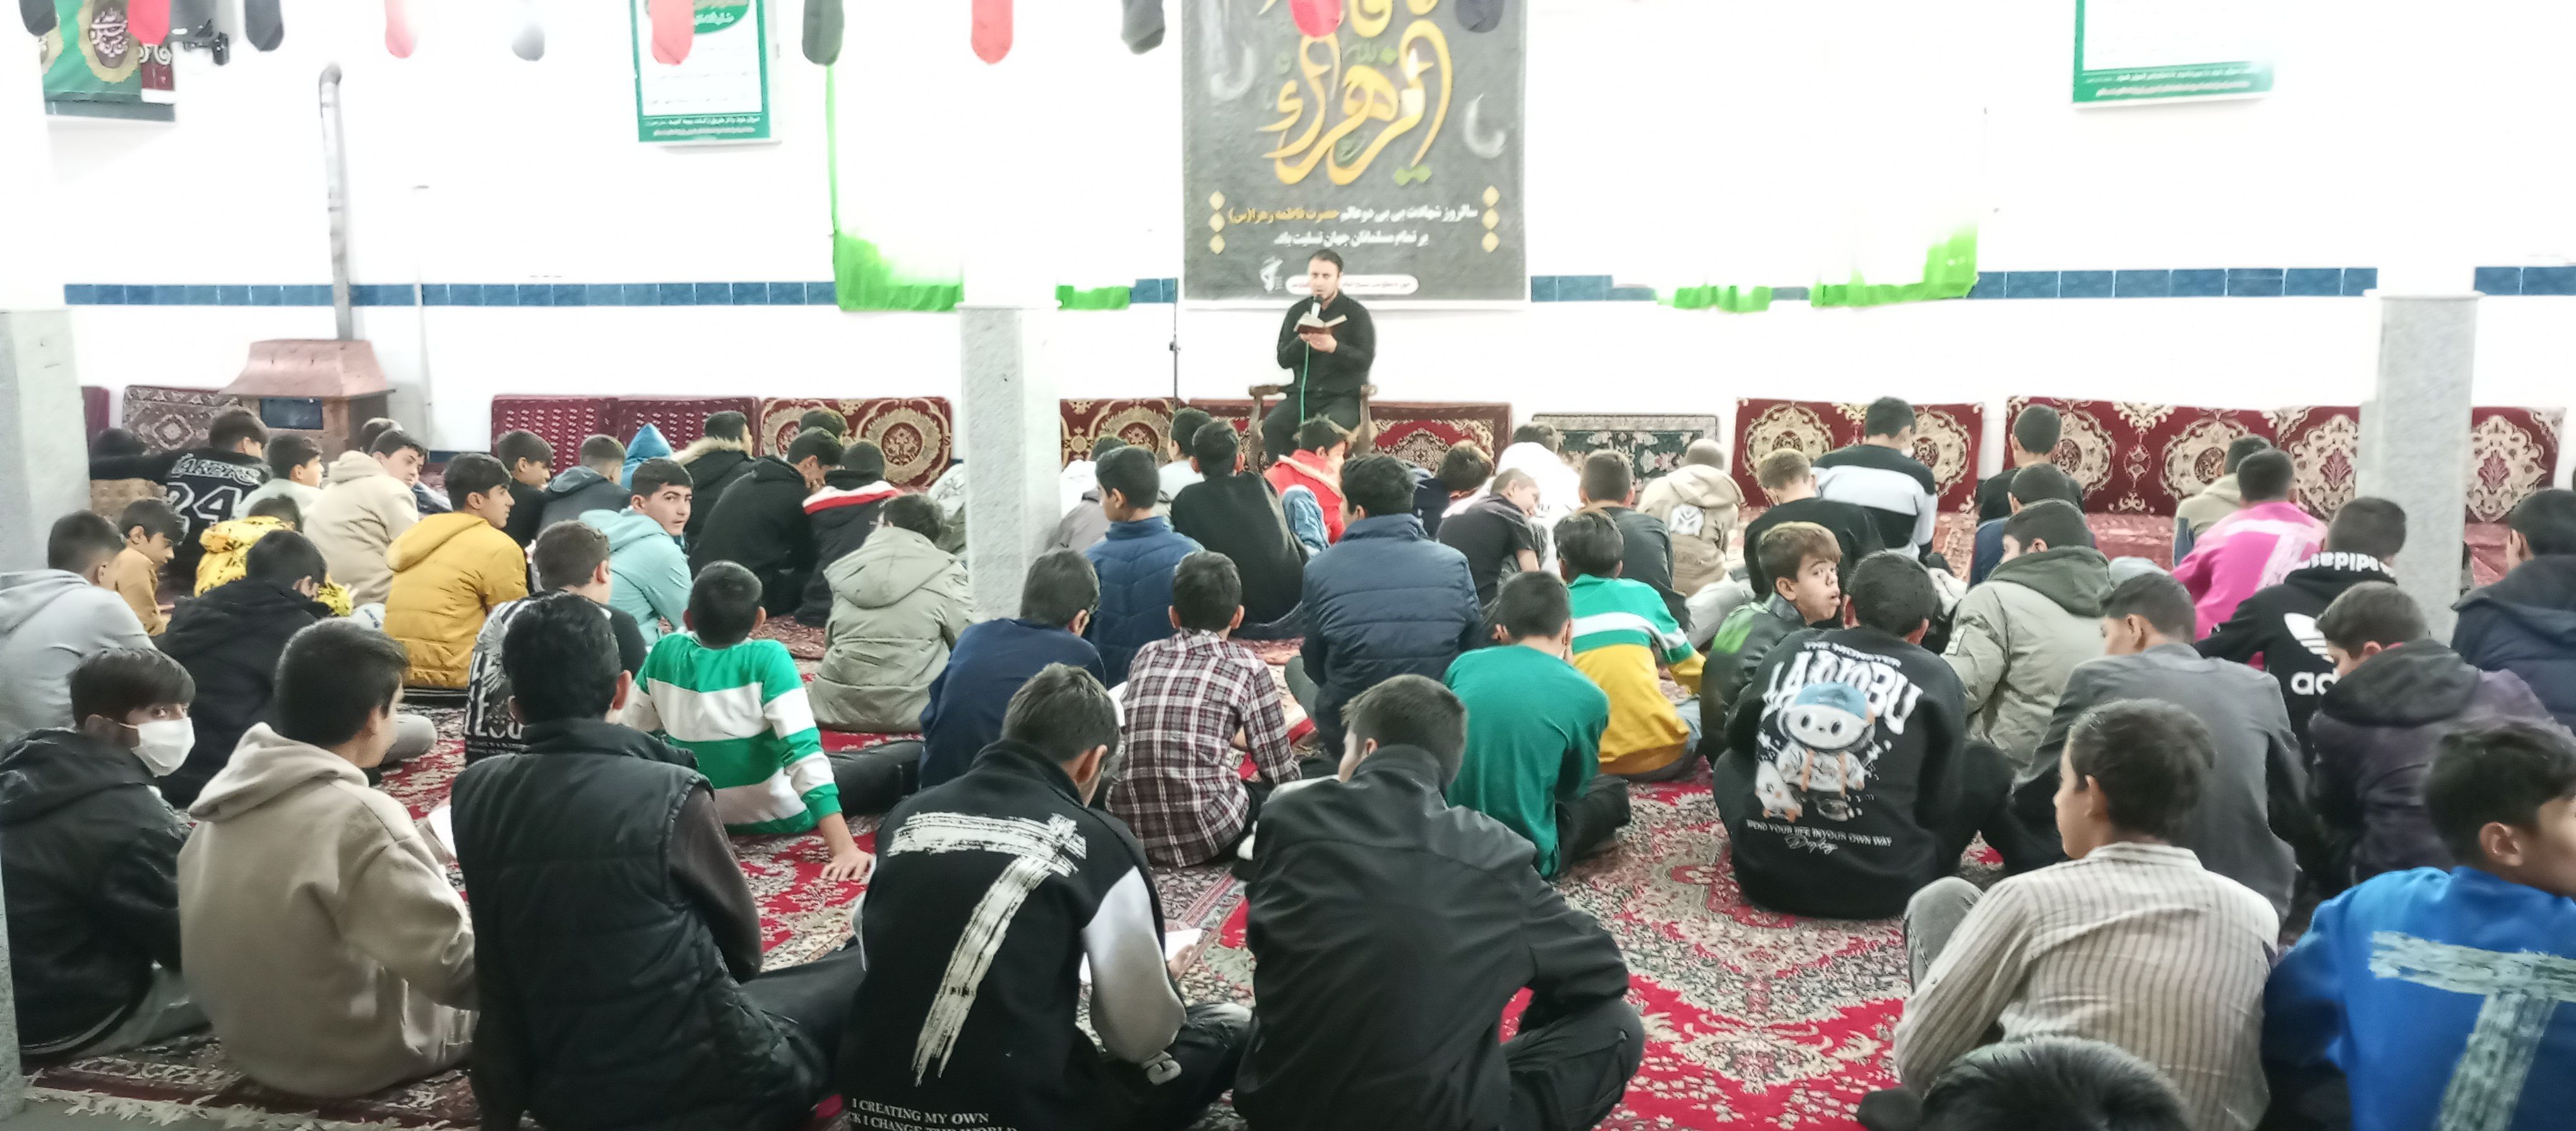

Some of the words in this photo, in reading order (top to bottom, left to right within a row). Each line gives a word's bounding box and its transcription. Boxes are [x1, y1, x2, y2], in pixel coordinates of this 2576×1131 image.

[859, 1099, 921, 1122] CREATING
[924, 1111, 948, 1124] MY
[951, 1112, 989, 1125] OWN
